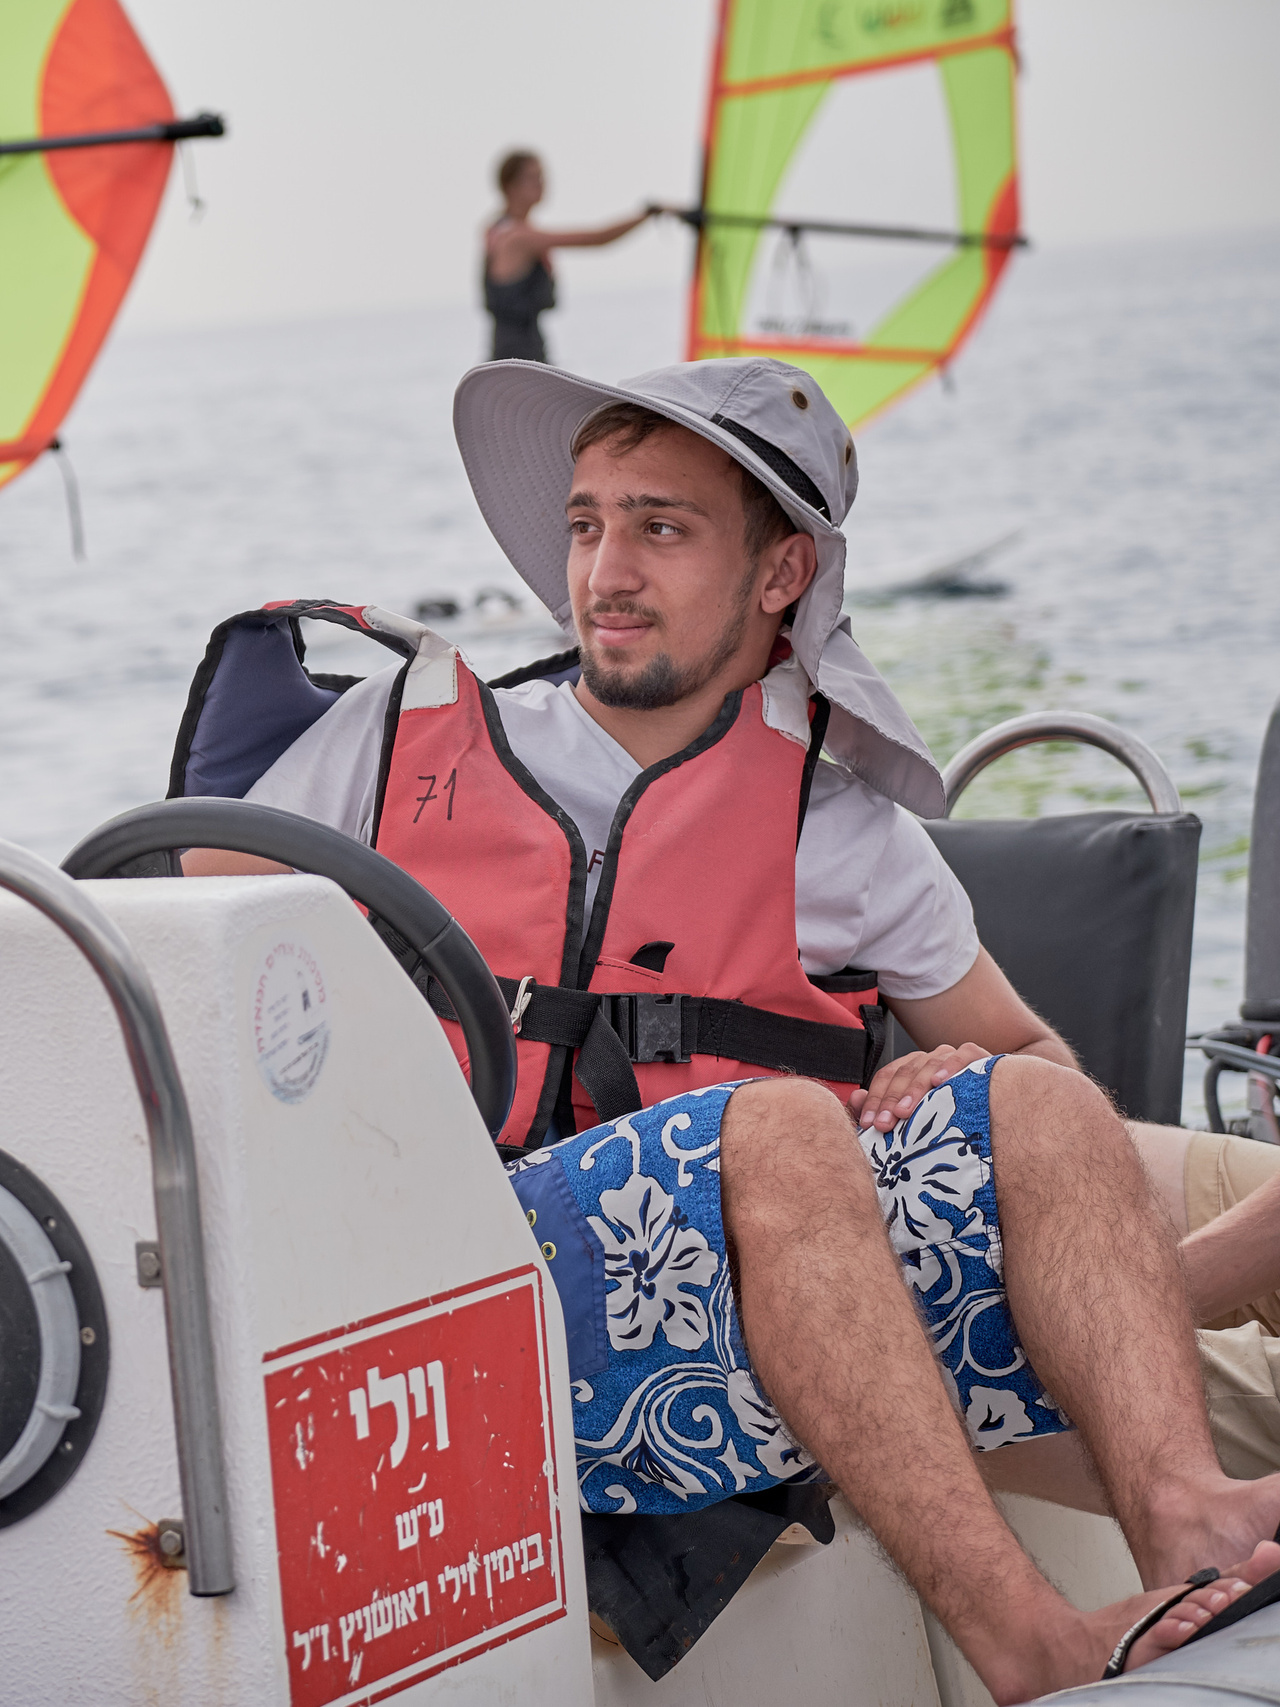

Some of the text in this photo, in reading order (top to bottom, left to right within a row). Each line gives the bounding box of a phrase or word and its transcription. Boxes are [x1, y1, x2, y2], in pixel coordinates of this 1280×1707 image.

[413, 768, 457, 824] 71
[483, 1532, 545, 1599] בנימין
[338, 1580, 431, 1663] ראושניץ
